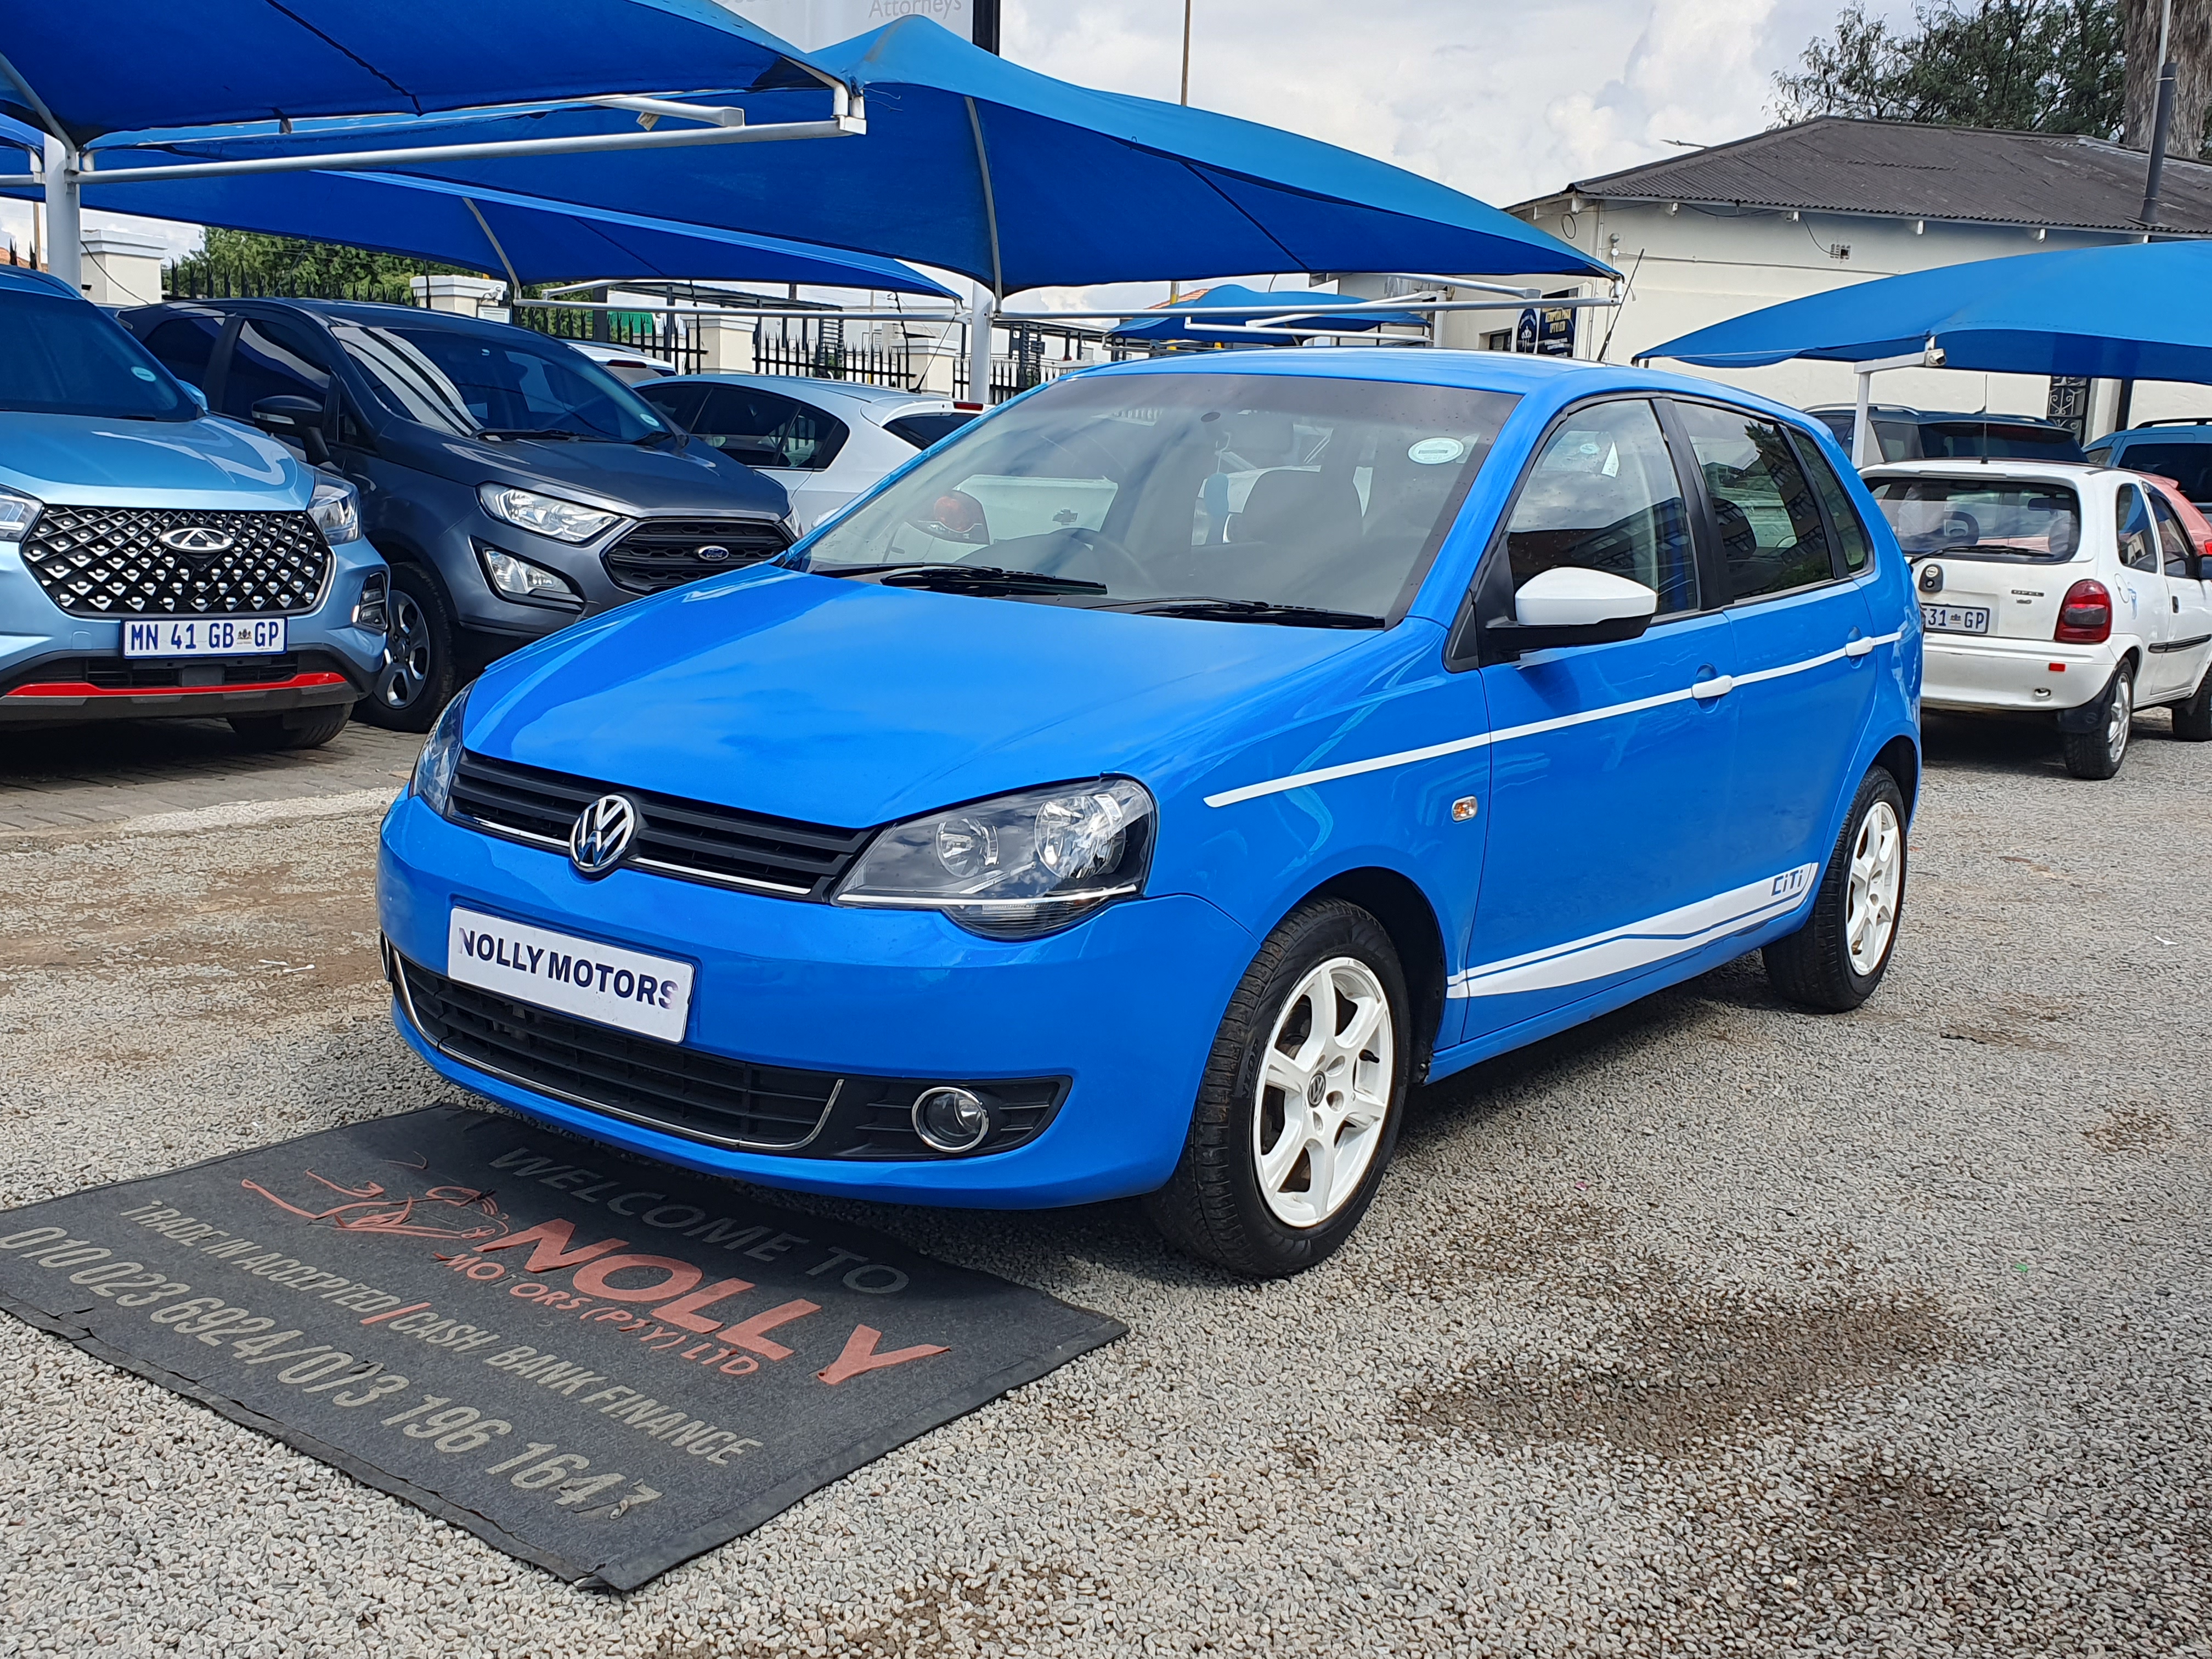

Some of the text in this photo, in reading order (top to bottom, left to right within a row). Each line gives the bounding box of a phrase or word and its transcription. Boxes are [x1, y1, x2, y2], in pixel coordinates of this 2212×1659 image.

[869, 0, 962, 20] Attorneys
[131, 621, 279, 651] MN 41 GB GP
[1922, 608, 1985, 629] 31 GP
[458, 927, 679, 1010] NOLLY MOTORS
[488, 1147, 910, 1294] WELCOME TO
[0, 1227, 112, 1268] 010
[69, 1262, 191, 1307] 023
[380, 1394, 513, 1453] 196
[120, 1200, 230, 1246] TRADE
[200, 1238, 262, 1258] IN
[579, 1385, 764, 1466] FINANCE
[472, 1218, 951, 1385] NOLLY
[680, 1342, 759, 1375] LTD
